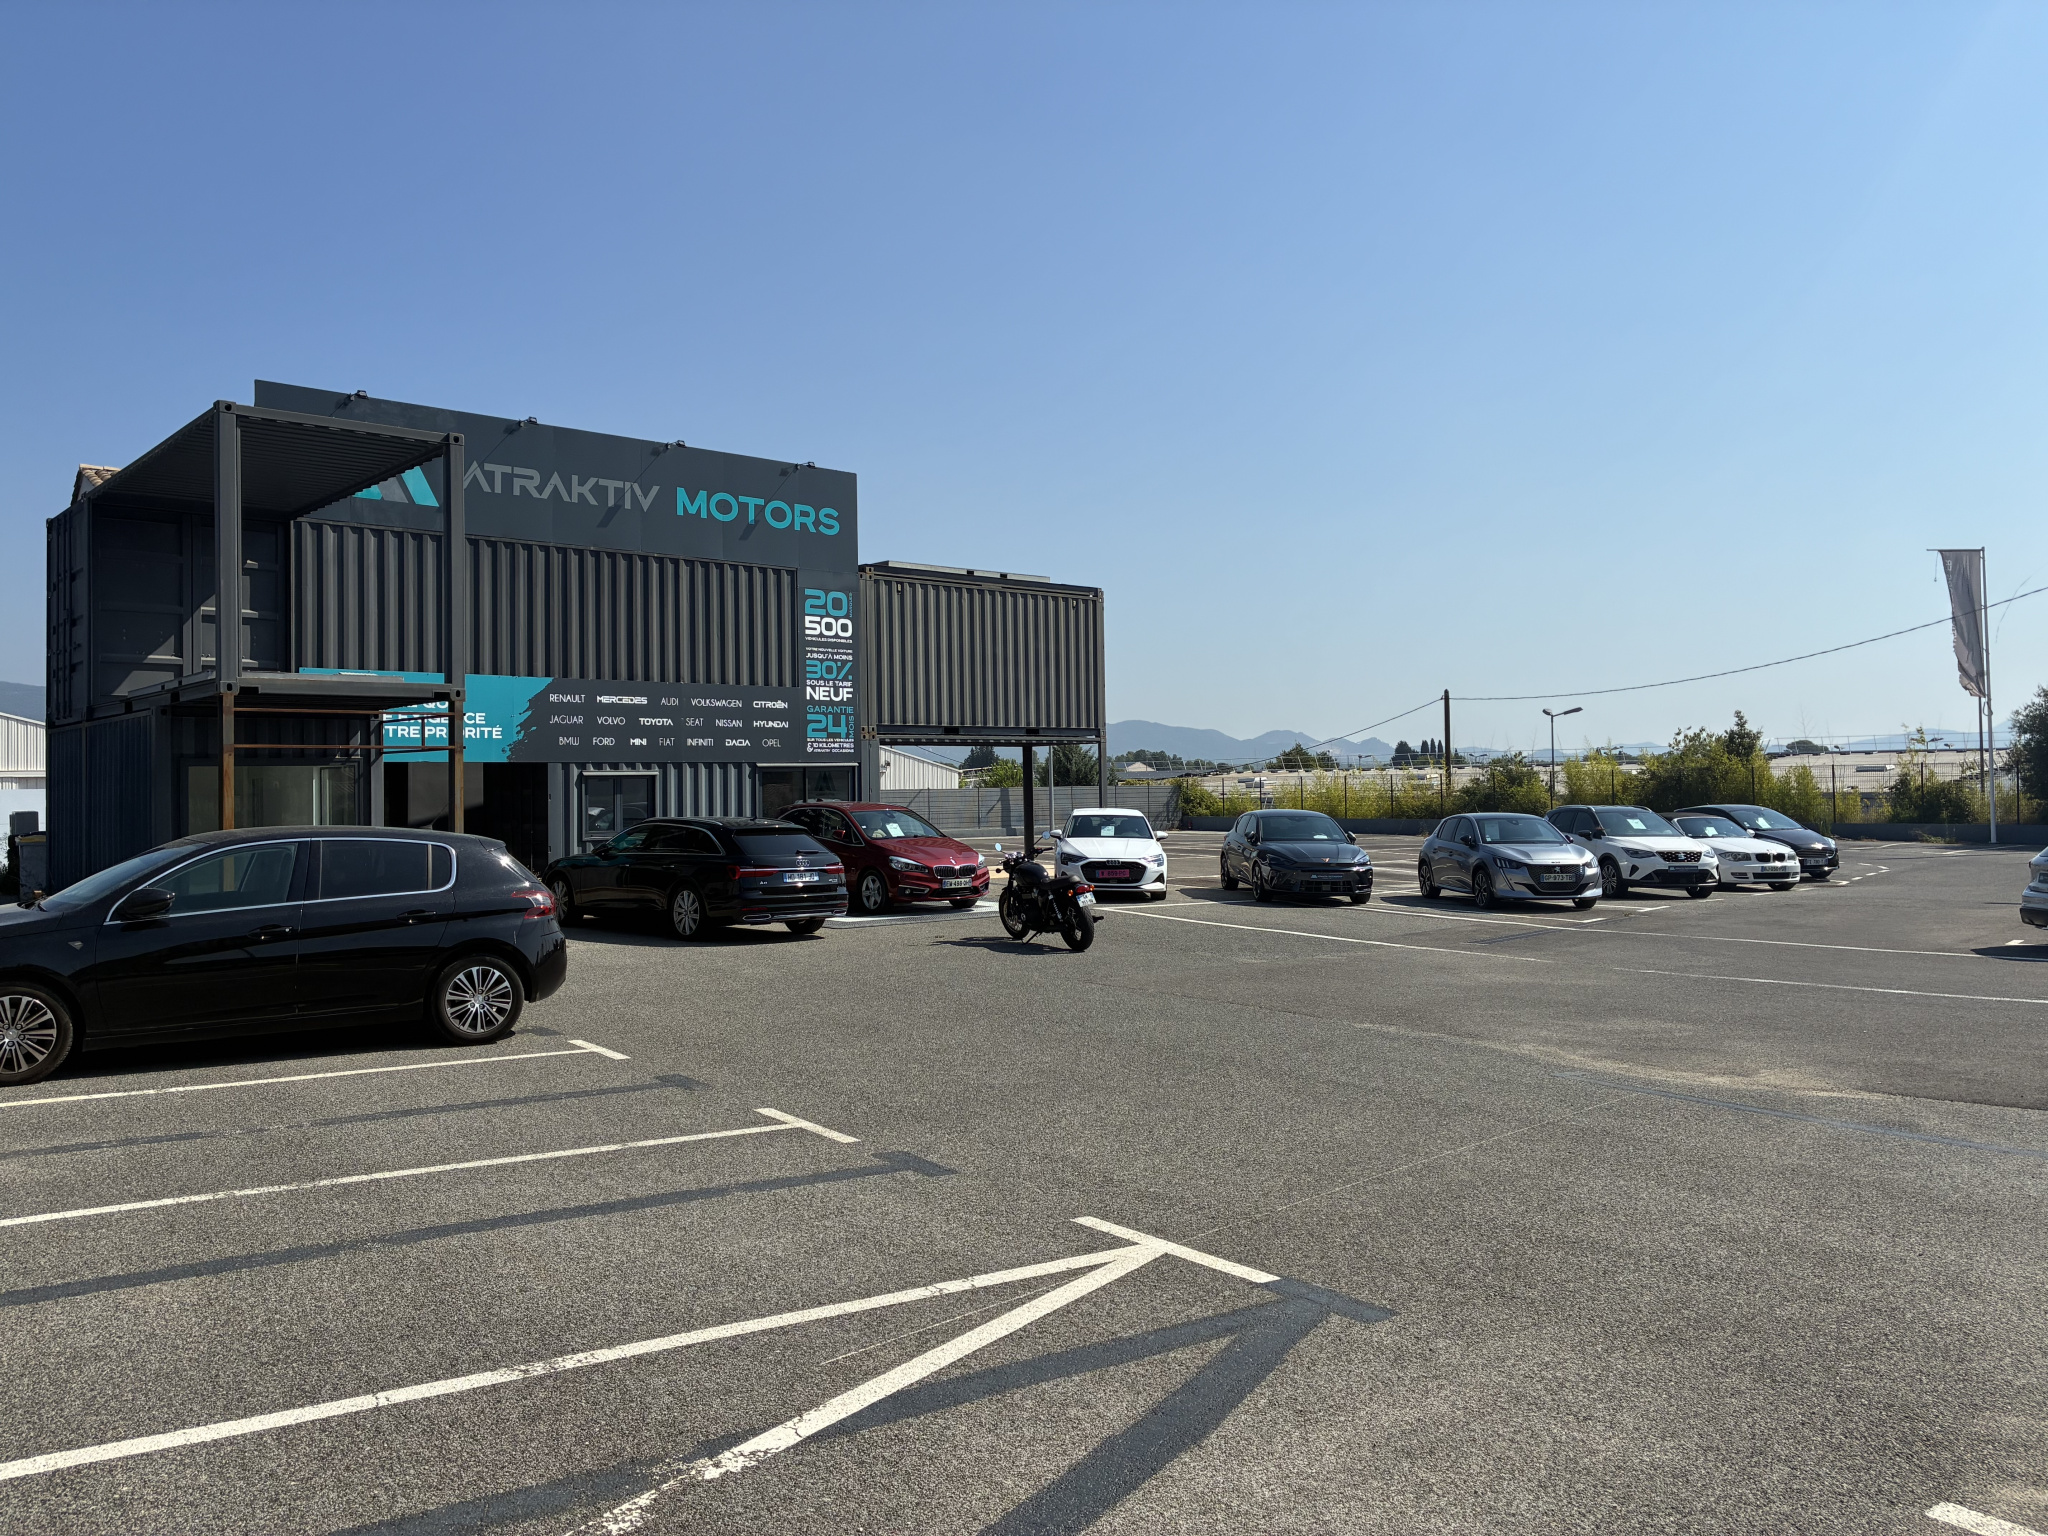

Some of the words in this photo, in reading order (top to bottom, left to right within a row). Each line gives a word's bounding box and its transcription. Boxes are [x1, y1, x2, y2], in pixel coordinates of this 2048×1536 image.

[464, 460, 660, 513] ATRAKTIV
[677, 486, 840, 536] MOTORS
[804, 588, 848, 616] 20
[804, 615, 853, 638] 500
[806, 660, 853, 680] 30%
[549, 694, 586, 703] RENAULT
[596, 695, 648, 705] MERCEDES
[660, 698, 679, 706] AUDI
[690, 698, 742, 708] VOLKSWAGEN
[753, 700, 788, 709] CITROËN
[806, 686, 854, 702] NEUF
[806, 705, 854, 714] GARANTIE
[549, 715, 584, 725] JAGUAR
[597, 716, 626, 725] VOLVO
[639, 718, 674, 726] TOYOTA
[686, 718, 704, 727] SEAT
[716, 719, 743, 728] NISSAN
[753, 720, 788, 728] HYUNDAI
[806, 714, 848, 738] 24
[425, 725, 502, 739] PRRITÉ
[558, 737, 580, 746] BMW
[592, 737, 616, 746] FORD
[630, 738, 647, 746] MINI
[659, 737, 675, 746] FIAT
[687, 738, 714, 746] INFINITI
[762, 738, 781, 747] OPEL
